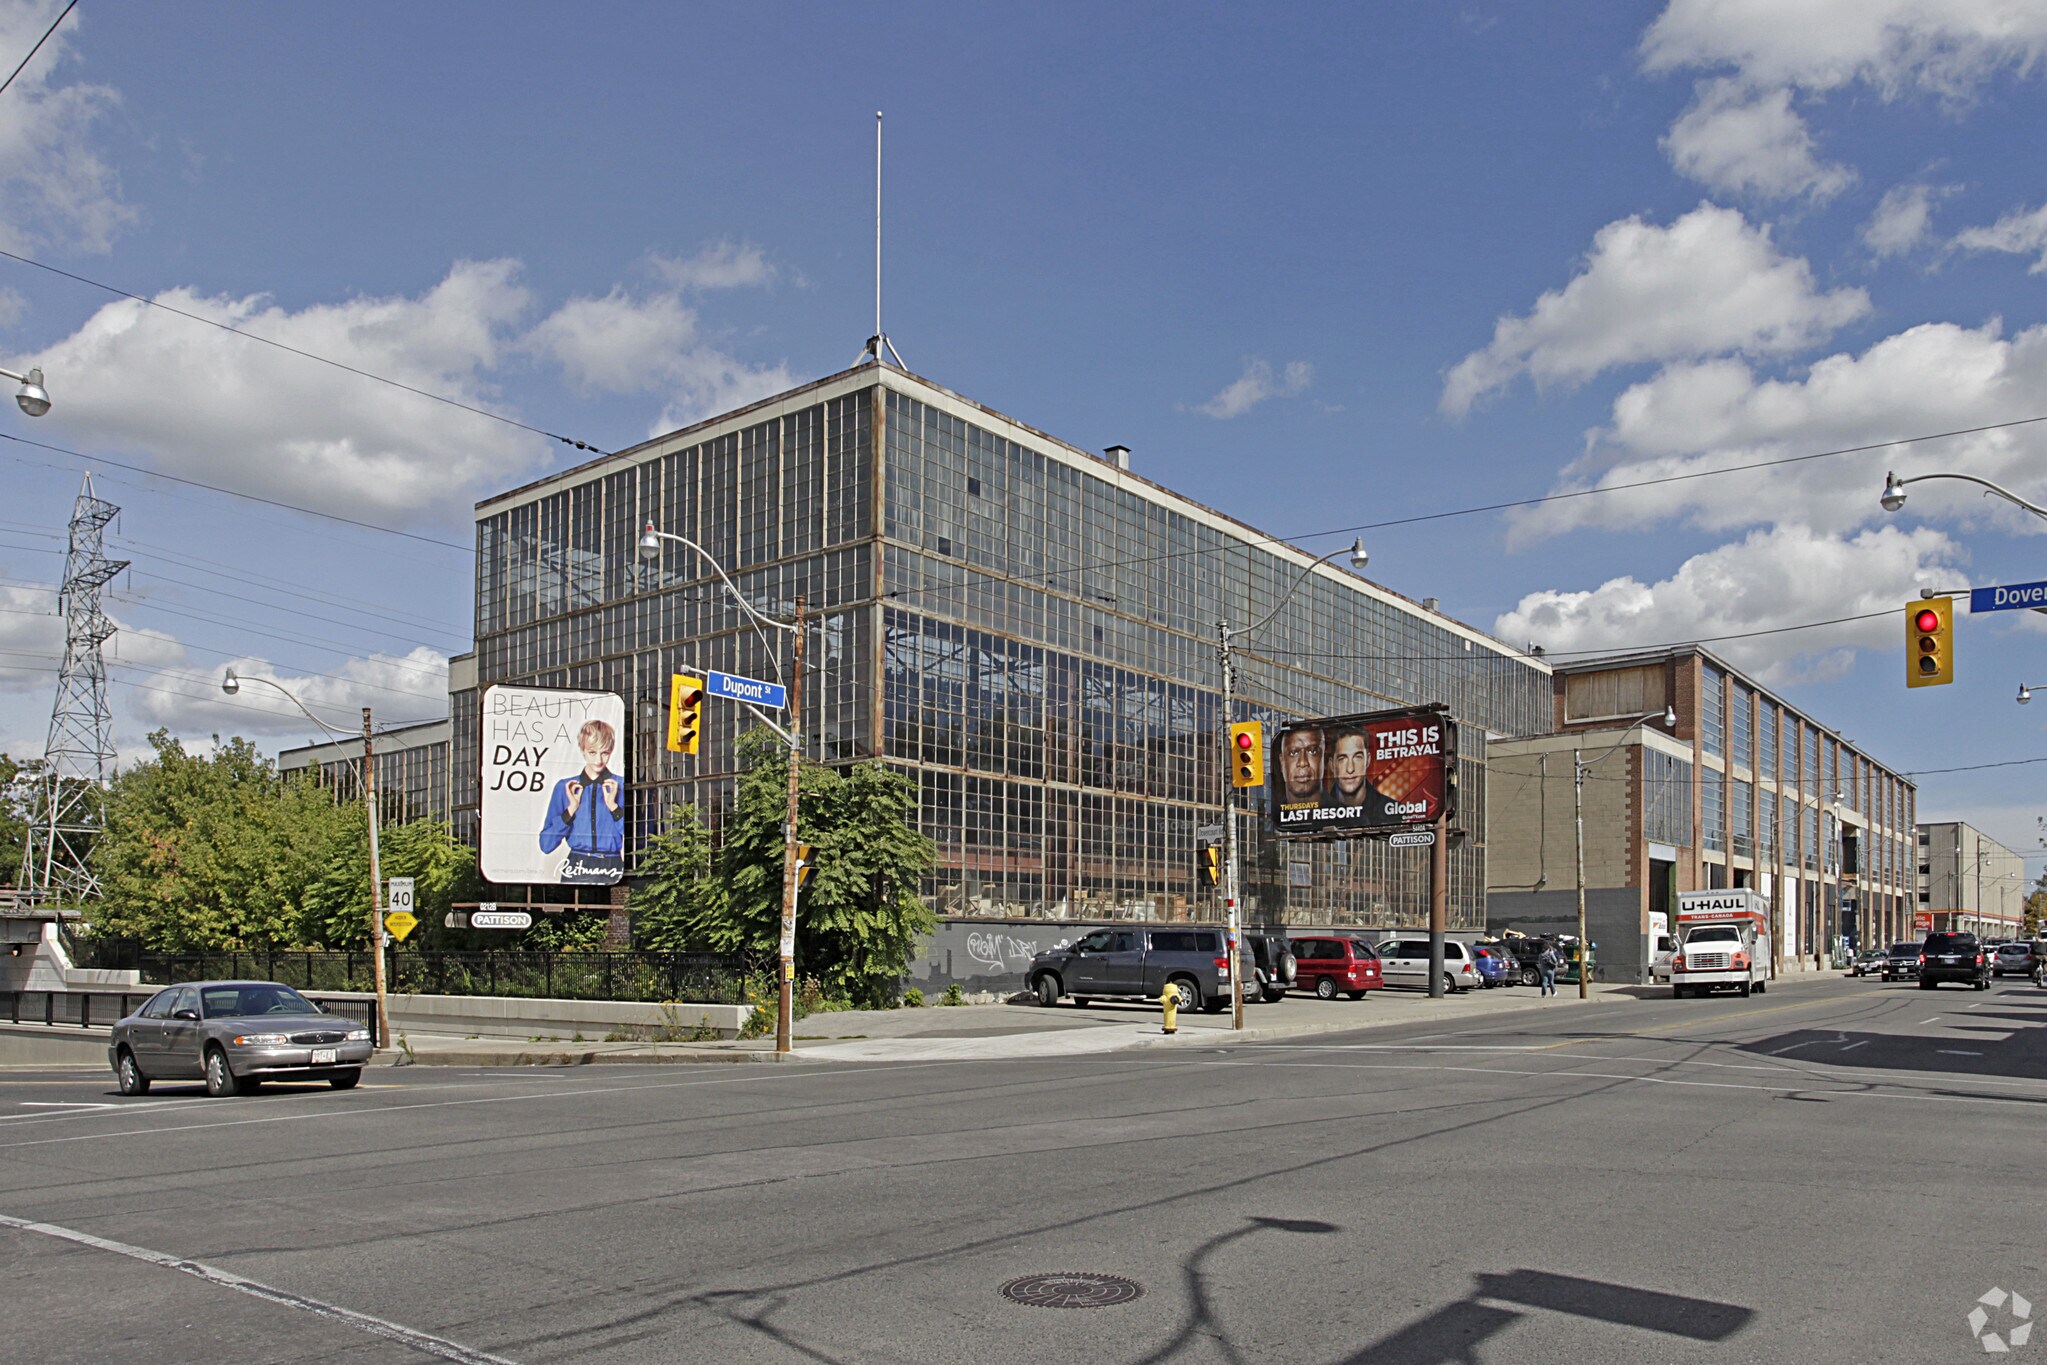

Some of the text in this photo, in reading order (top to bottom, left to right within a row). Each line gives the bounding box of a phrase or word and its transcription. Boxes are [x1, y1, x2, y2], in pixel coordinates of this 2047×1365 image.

[723, 676, 771, 699] Dupont St
[493, 693, 594, 719] BEAUTY
[493, 719, 571, 744] HAS A
[1375, 726, 1440, 748] THIS IS
[493, 745, 550, 767] DAY
[1376, 743, 1440, 761] BETRAYAL
[490, 770, 545, 792] JOB
[1280, 801, 1319, 811] THURSDAYS
[1280, 805, 1363, 823] LAST RESORT
[1384, 799, 1427, 815] Global
[1392, 834, 1432, 845] PATTISON
[553, 858, 623, 878] Reitmans
[392, 892, 410, 906] 40
[1682, 899, 1744, 911] U-HAUL
[476, 915, 527, 925] PATTISON
